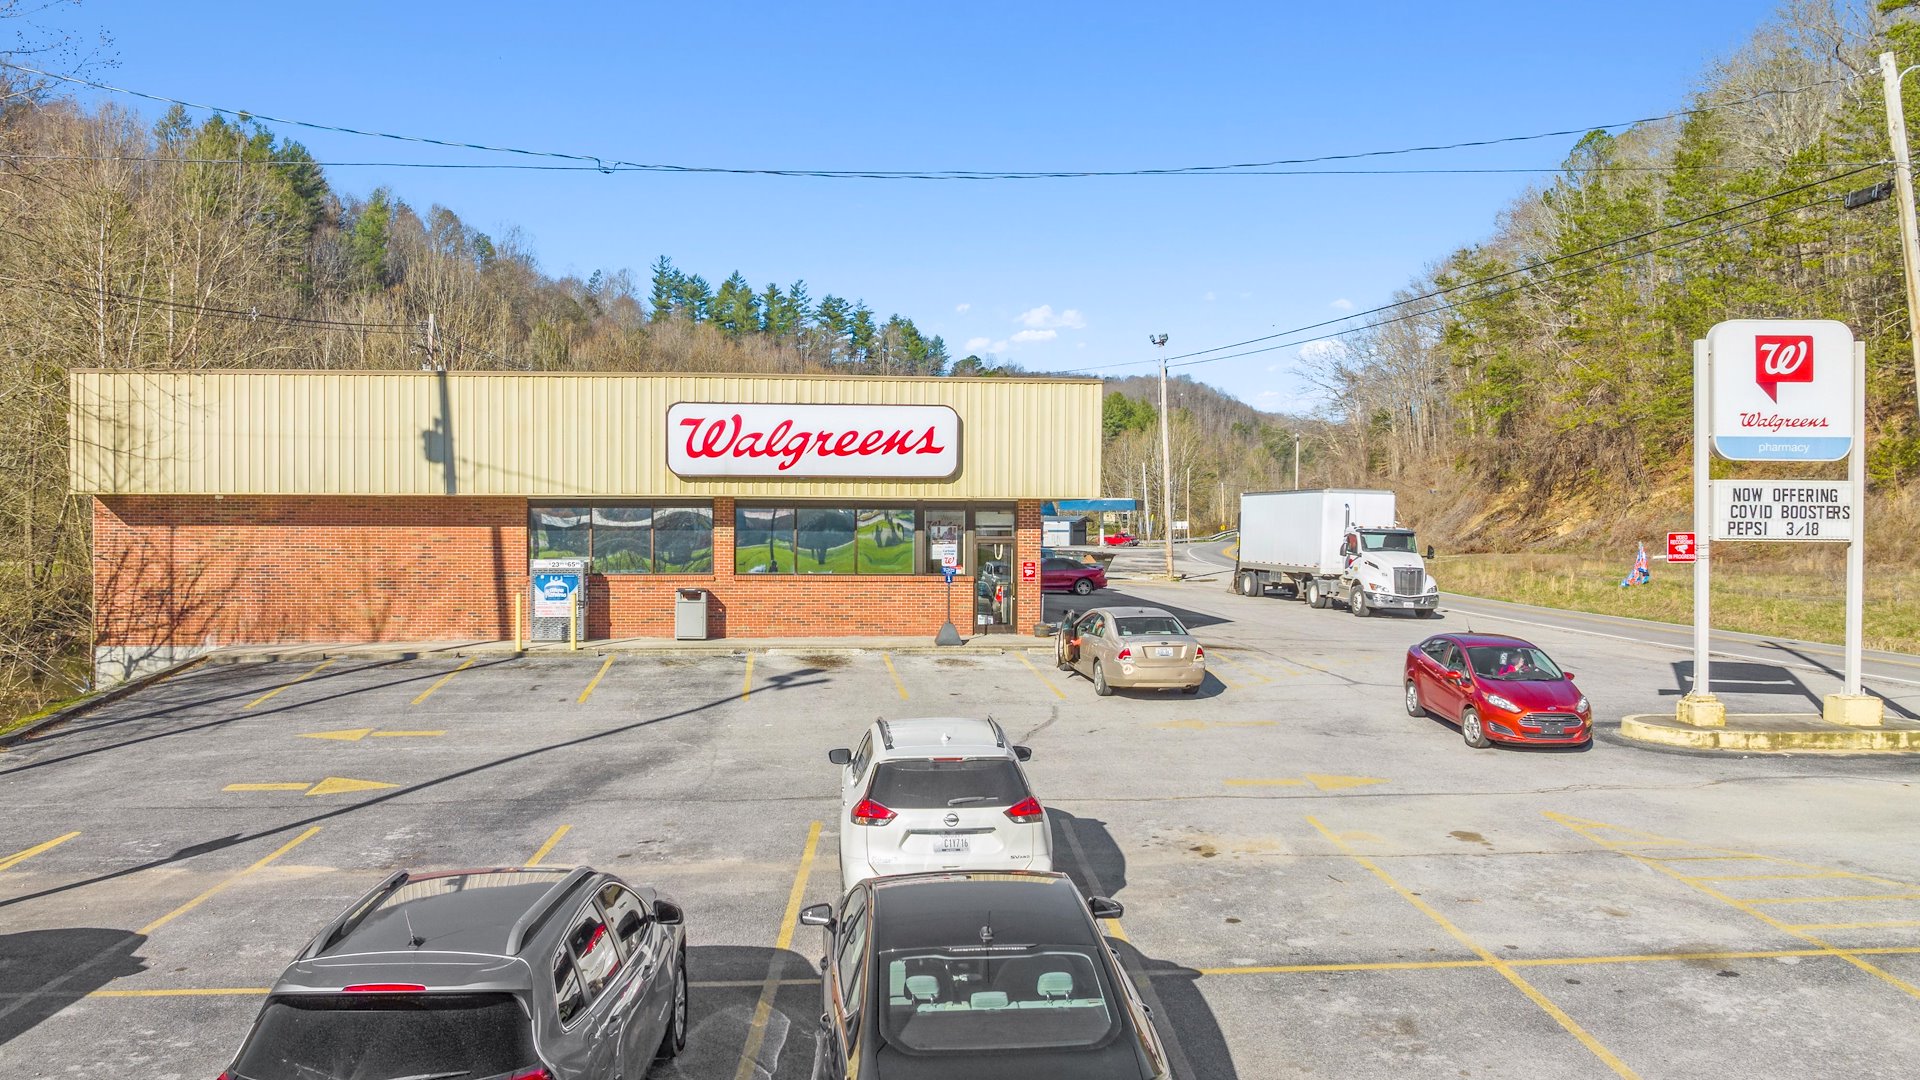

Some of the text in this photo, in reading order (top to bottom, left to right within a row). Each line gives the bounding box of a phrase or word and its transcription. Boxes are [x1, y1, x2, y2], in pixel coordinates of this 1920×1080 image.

[1760, 340, 1808, 375] W
[1739, 411, 1830, 433] Walgreens
[679, 413, 946, 471] Walgreens
[1758, 442, 1811, 453] pharmacy
[1732, 487, 1839, 503] NOW OFFERING
[1730, 504, 1850, 520] COVID BOOSTERS
[1727, 521, 1820, 536] PEPSI 3/18
